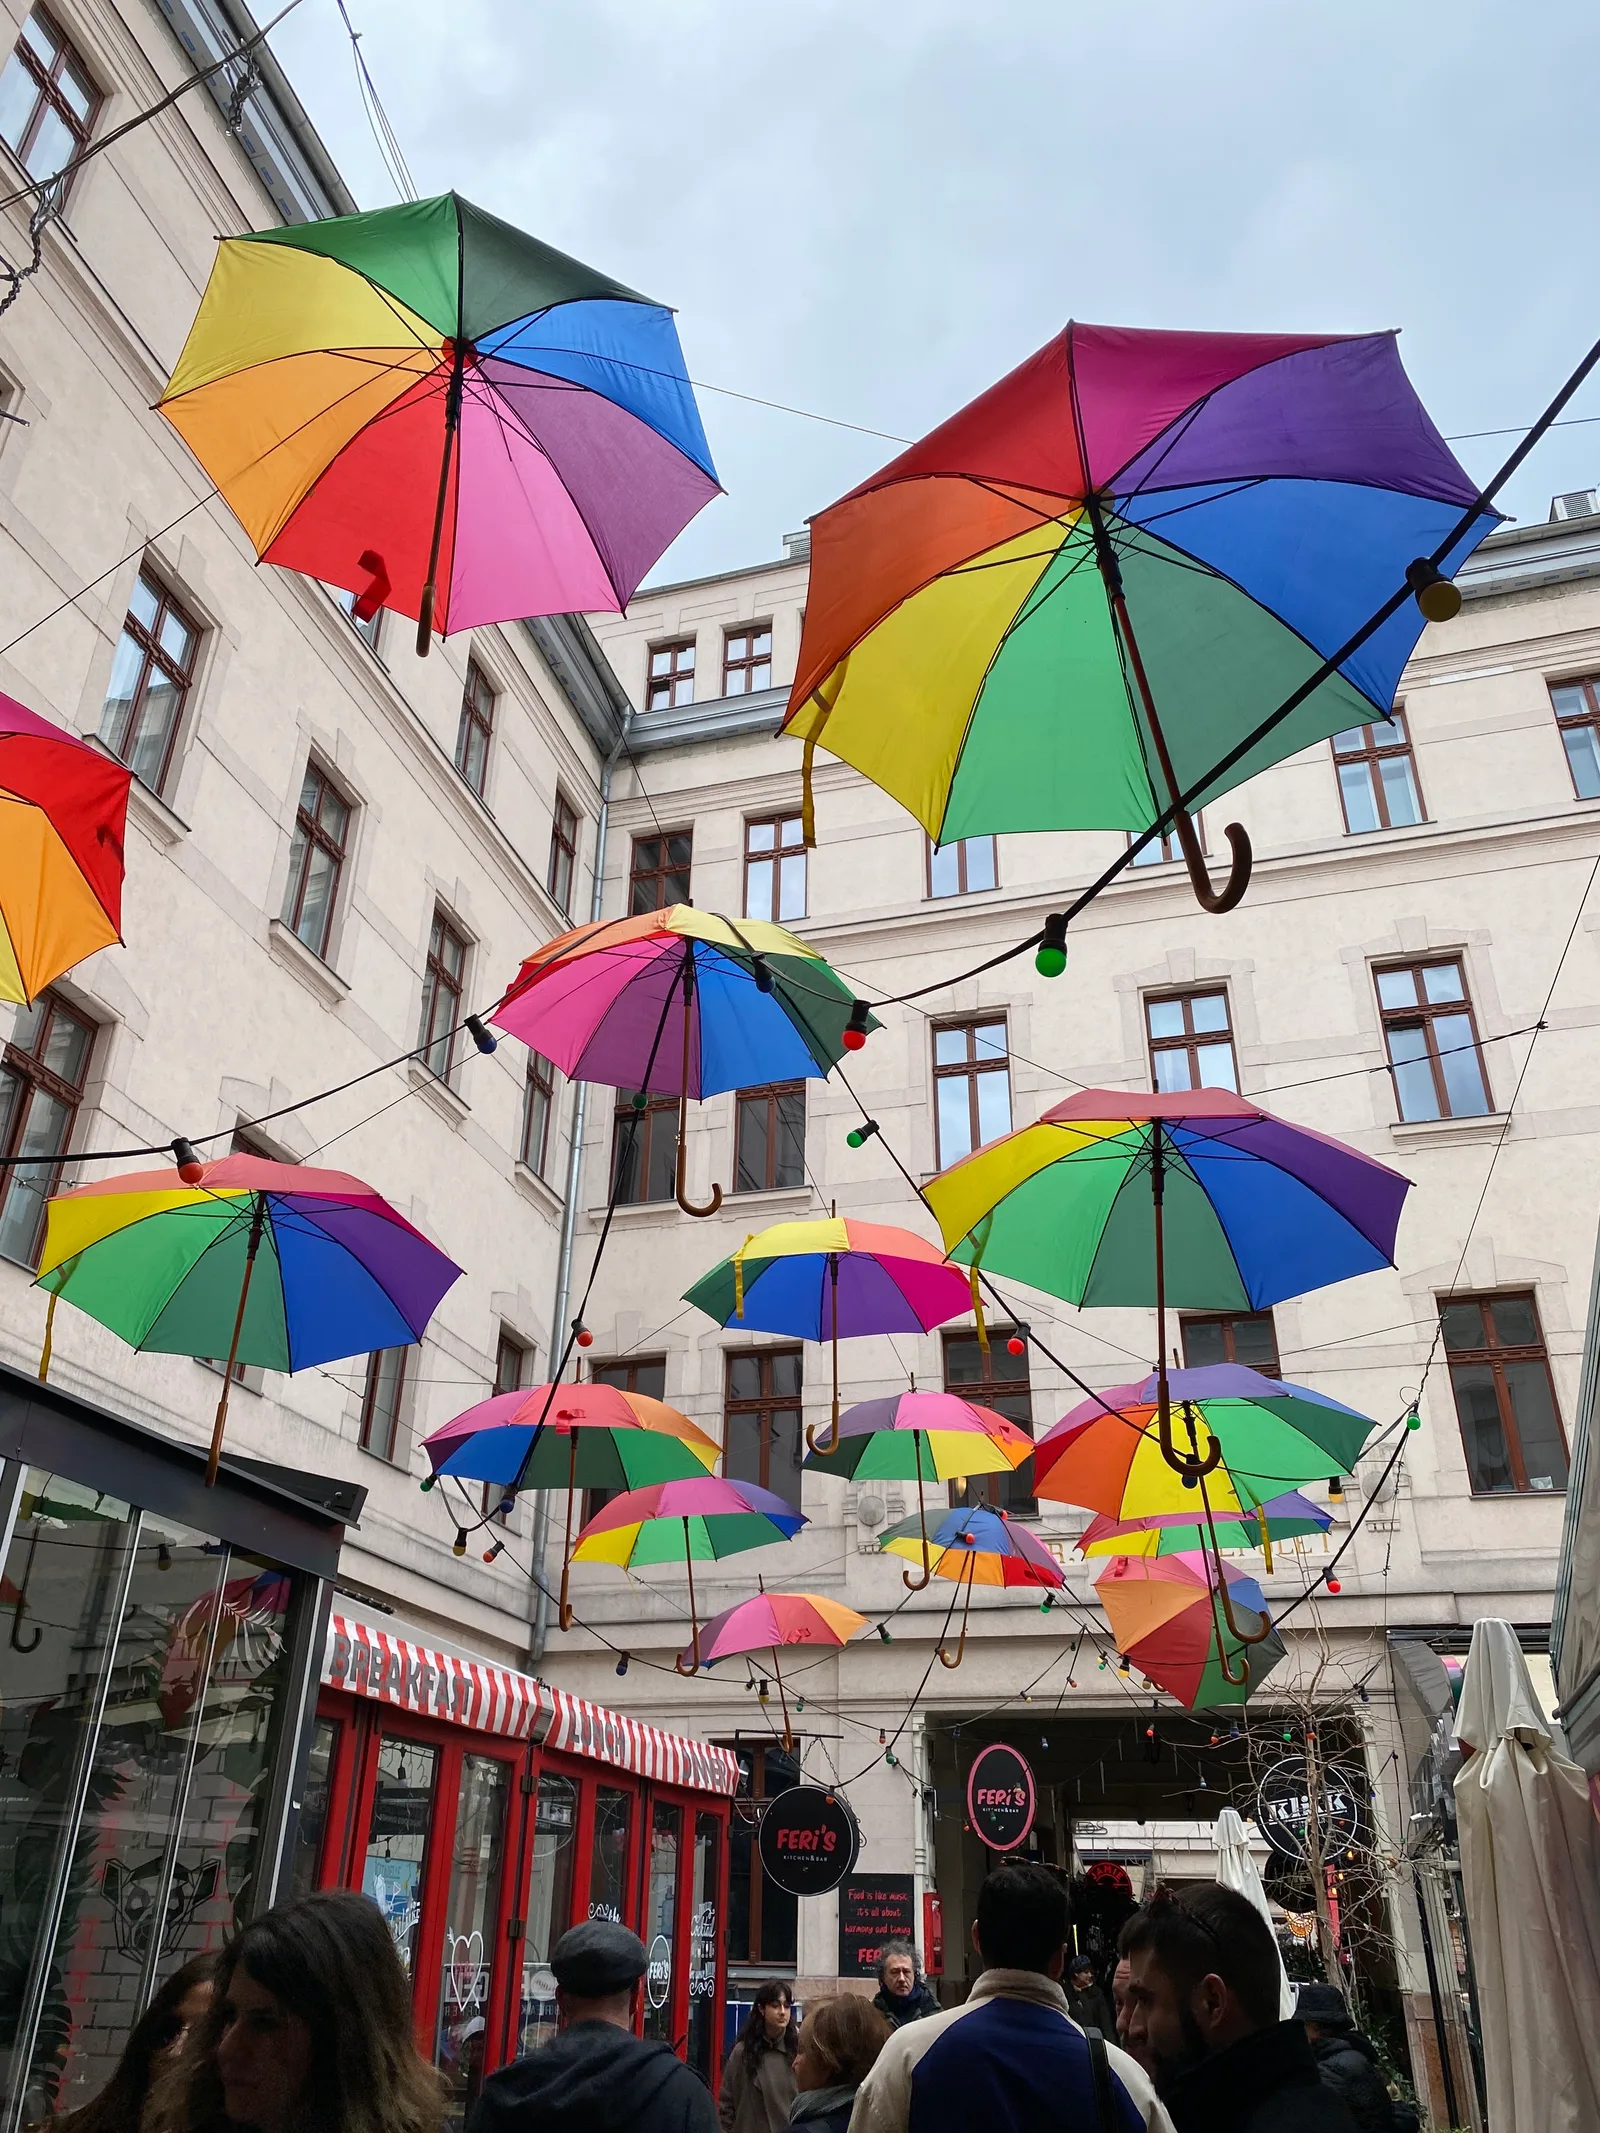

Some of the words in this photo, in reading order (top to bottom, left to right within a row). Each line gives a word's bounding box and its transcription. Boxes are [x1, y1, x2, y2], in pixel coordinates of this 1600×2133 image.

[329, 1633, 473, 1716] BREAKFAST
[568, 1708, 626, 1760] LUNCH
[681, 1747, 727, 1788] DINNER
[1091, 1865, 1124, 1880] JAMIE
[847, 1888, 865, 1900] Food
[866, 1891, 873, 1900] is
[874, 1890, 887, 1901] like
[871, 1906, 880, 1917] all
[881, 1906, 902, 1917] about
[844, 1922, 874, 1935] harmony
[875, 1923, 888, 1934] and
[890, 1924, 911, 1938] timing
[858, 1948, 883, 1964] FER
